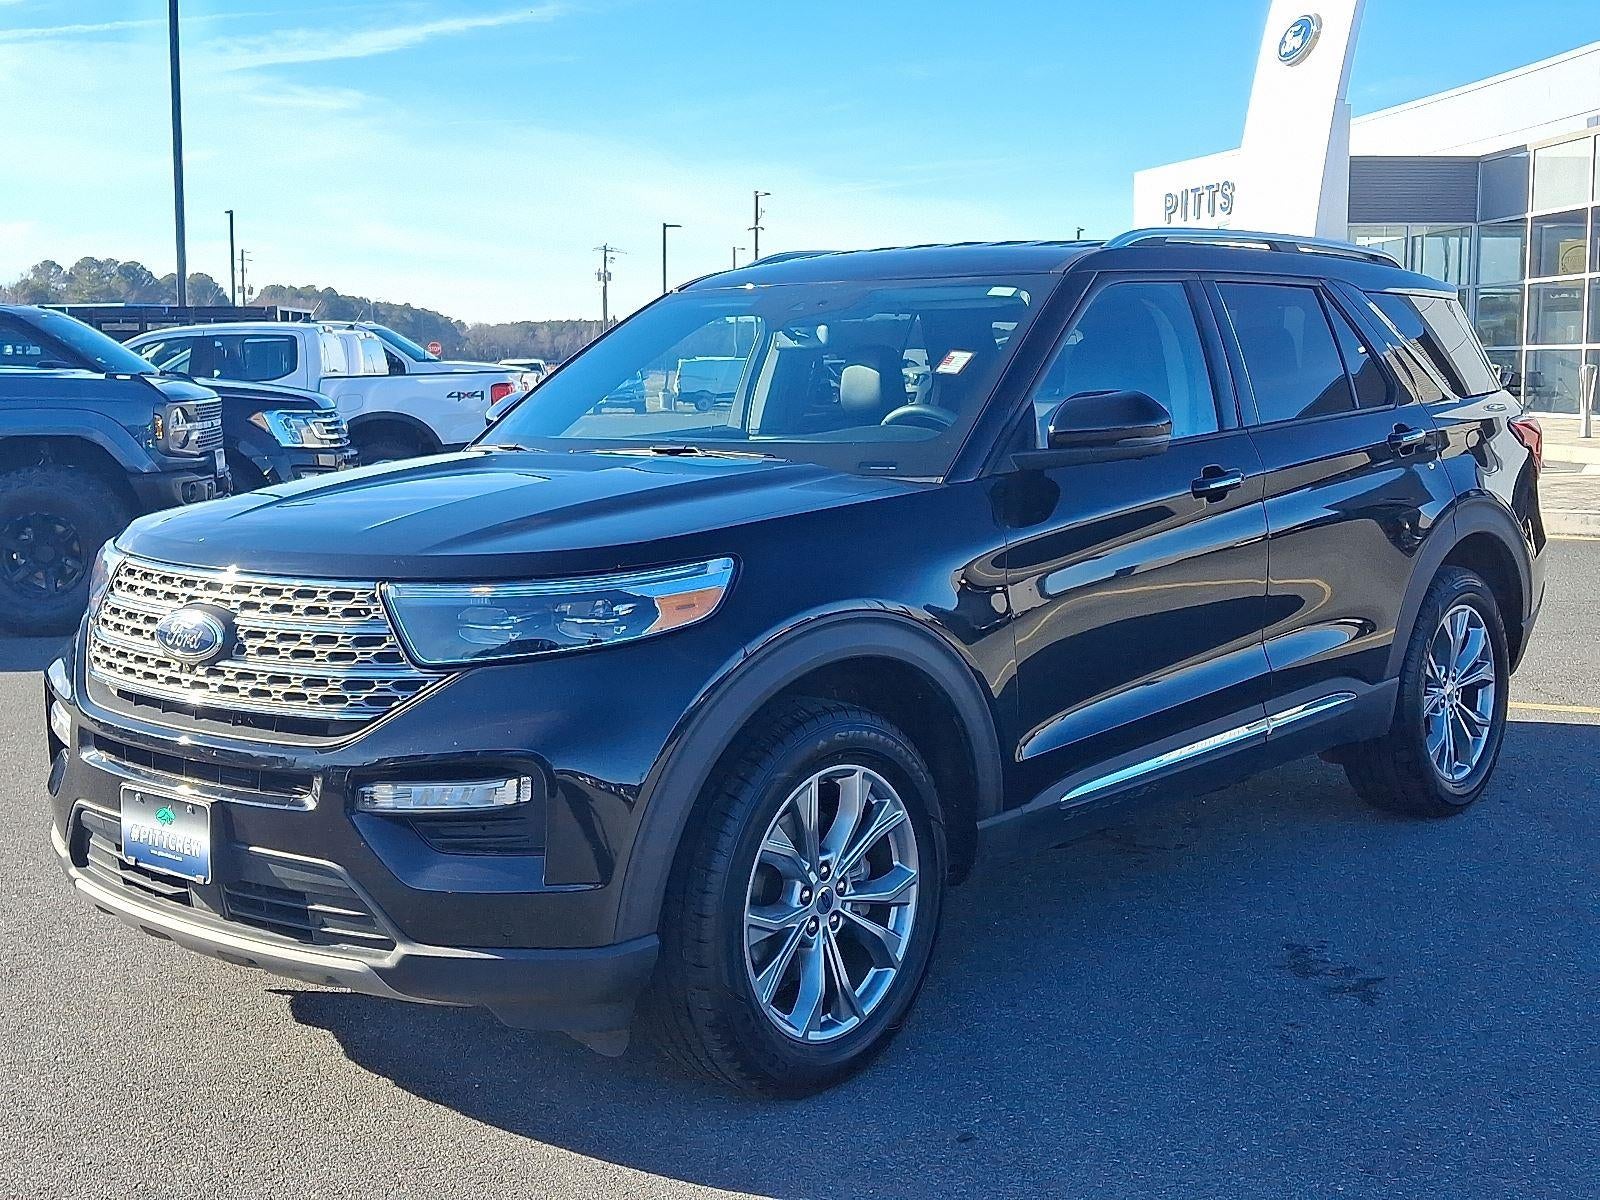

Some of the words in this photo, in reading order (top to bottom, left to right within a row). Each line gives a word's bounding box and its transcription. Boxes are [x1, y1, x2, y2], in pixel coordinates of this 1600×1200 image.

[1164, 180, 1235, 224] PITTS
[446, 390, 484, 402] 4x4
[165, 620, 204, 650] Ford
